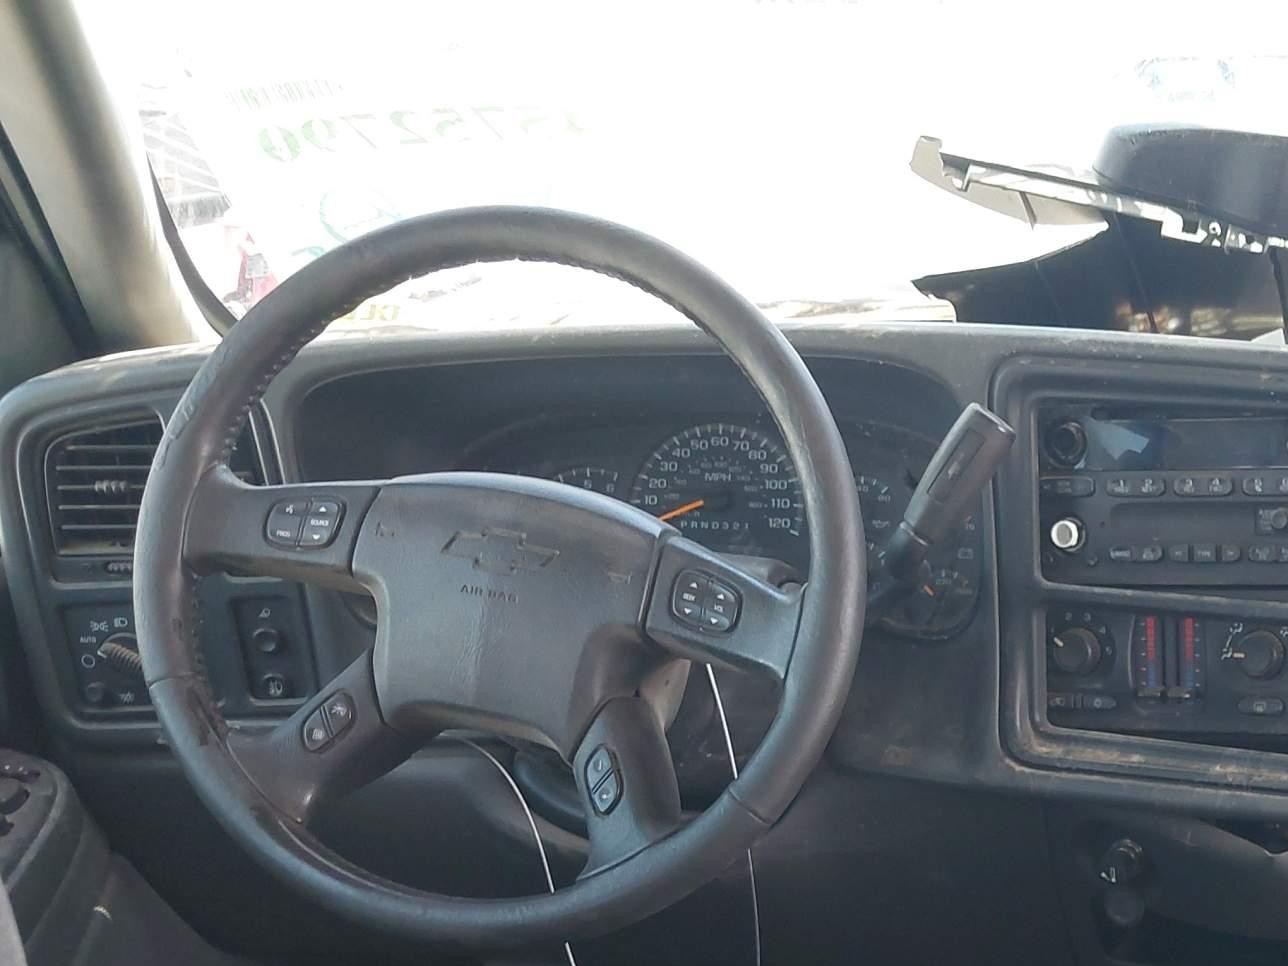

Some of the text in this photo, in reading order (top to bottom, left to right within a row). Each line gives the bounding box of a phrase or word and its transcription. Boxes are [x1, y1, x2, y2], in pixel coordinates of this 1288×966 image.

[690, 440, 709, 450] 50
[711, 436, 729, 446] 60
[733, 441, 750, 451] 70
[672, 448, 690, 458] 40
[748, 450, 767, 461] 80
[660, 462, 678, 472] 30
[760, 464, 778, 474] 90
[705, 472, 732, 482] MPH
[649, 478, 667, 489] 20
[765, 479, 788, 490] 100
[644, 495, 658, 505] 10
[771, 498, 791, 509] 110
[768, 518, 791, 529] 120
[460, 584, 520, 604] AIR BAG
[80, 636, 97, 644] AUTO
